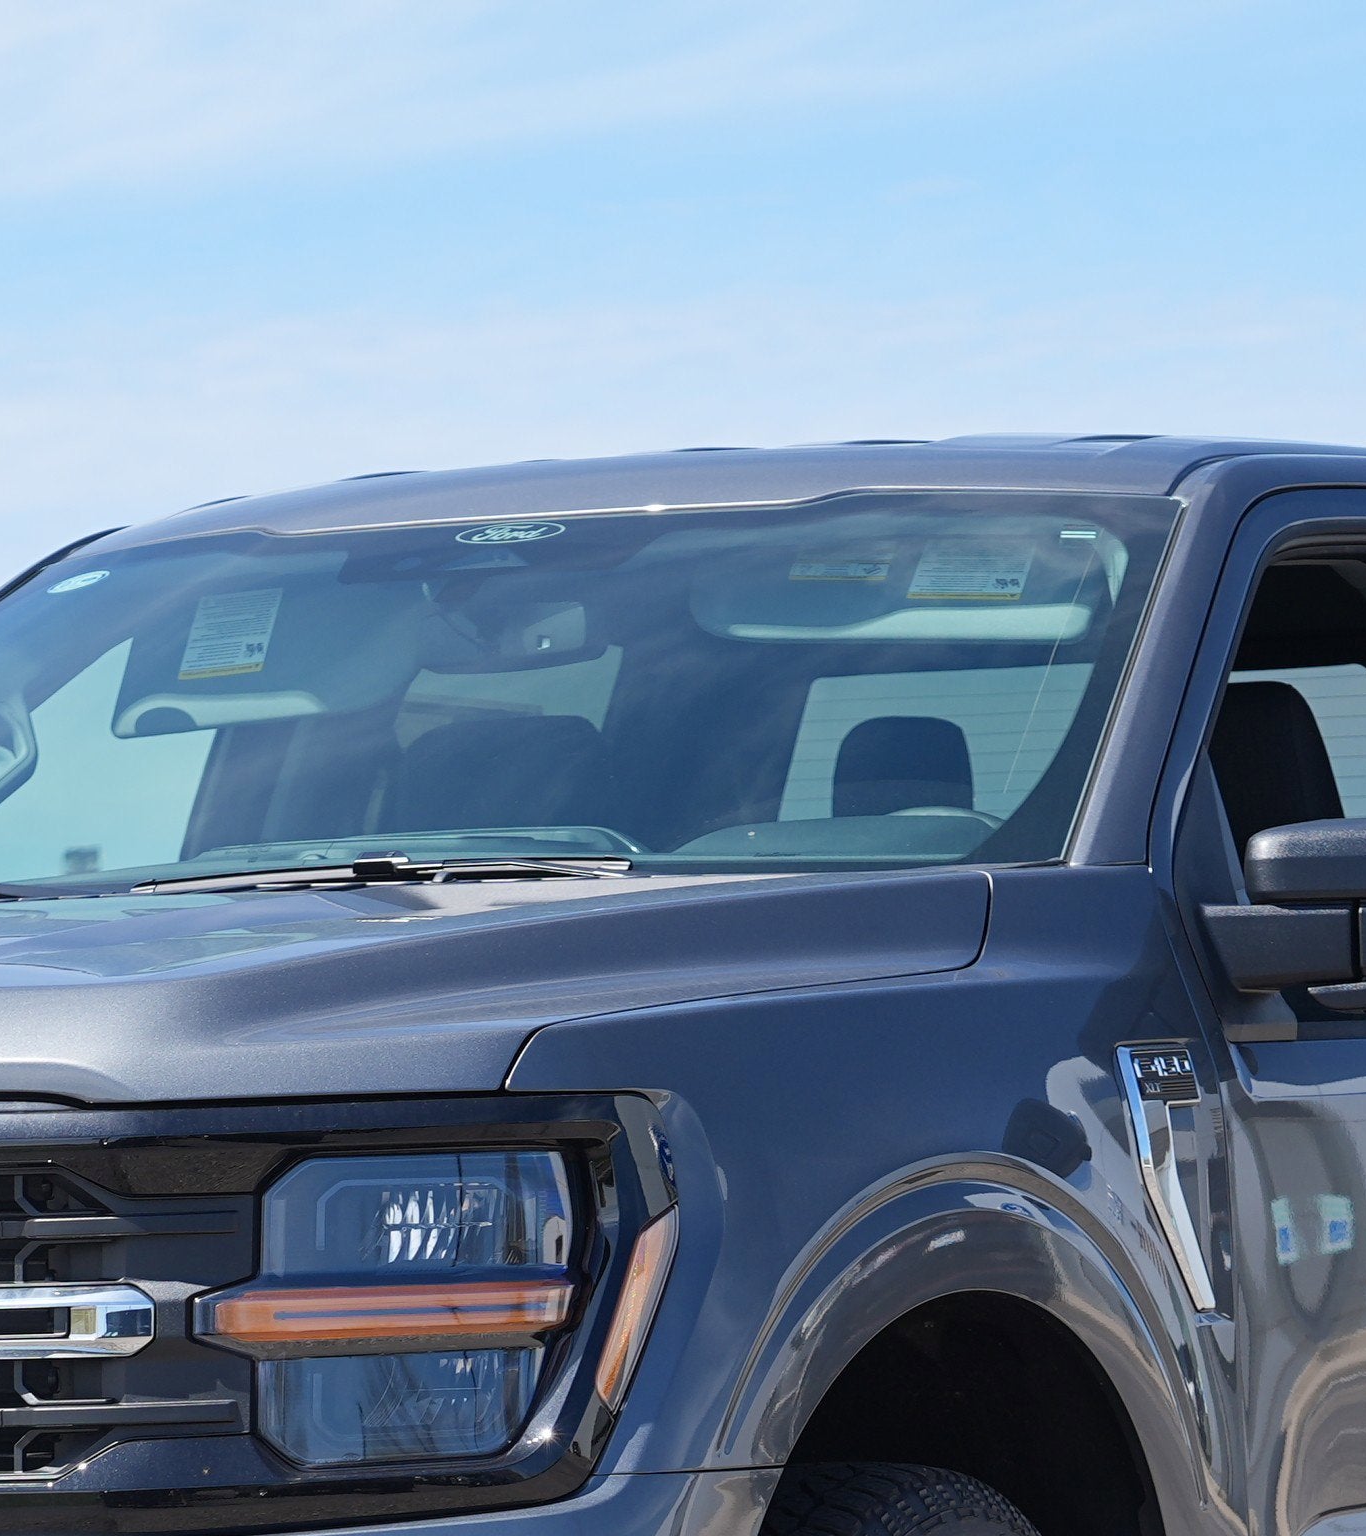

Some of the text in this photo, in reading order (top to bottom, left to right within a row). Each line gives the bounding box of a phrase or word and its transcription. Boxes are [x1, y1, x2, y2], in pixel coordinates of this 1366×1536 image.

[471, 524, 549, 541] Ford
[1133, 1056, 1192, 1078] F-150
[1144, 1082, 1161, 1094] XLT
